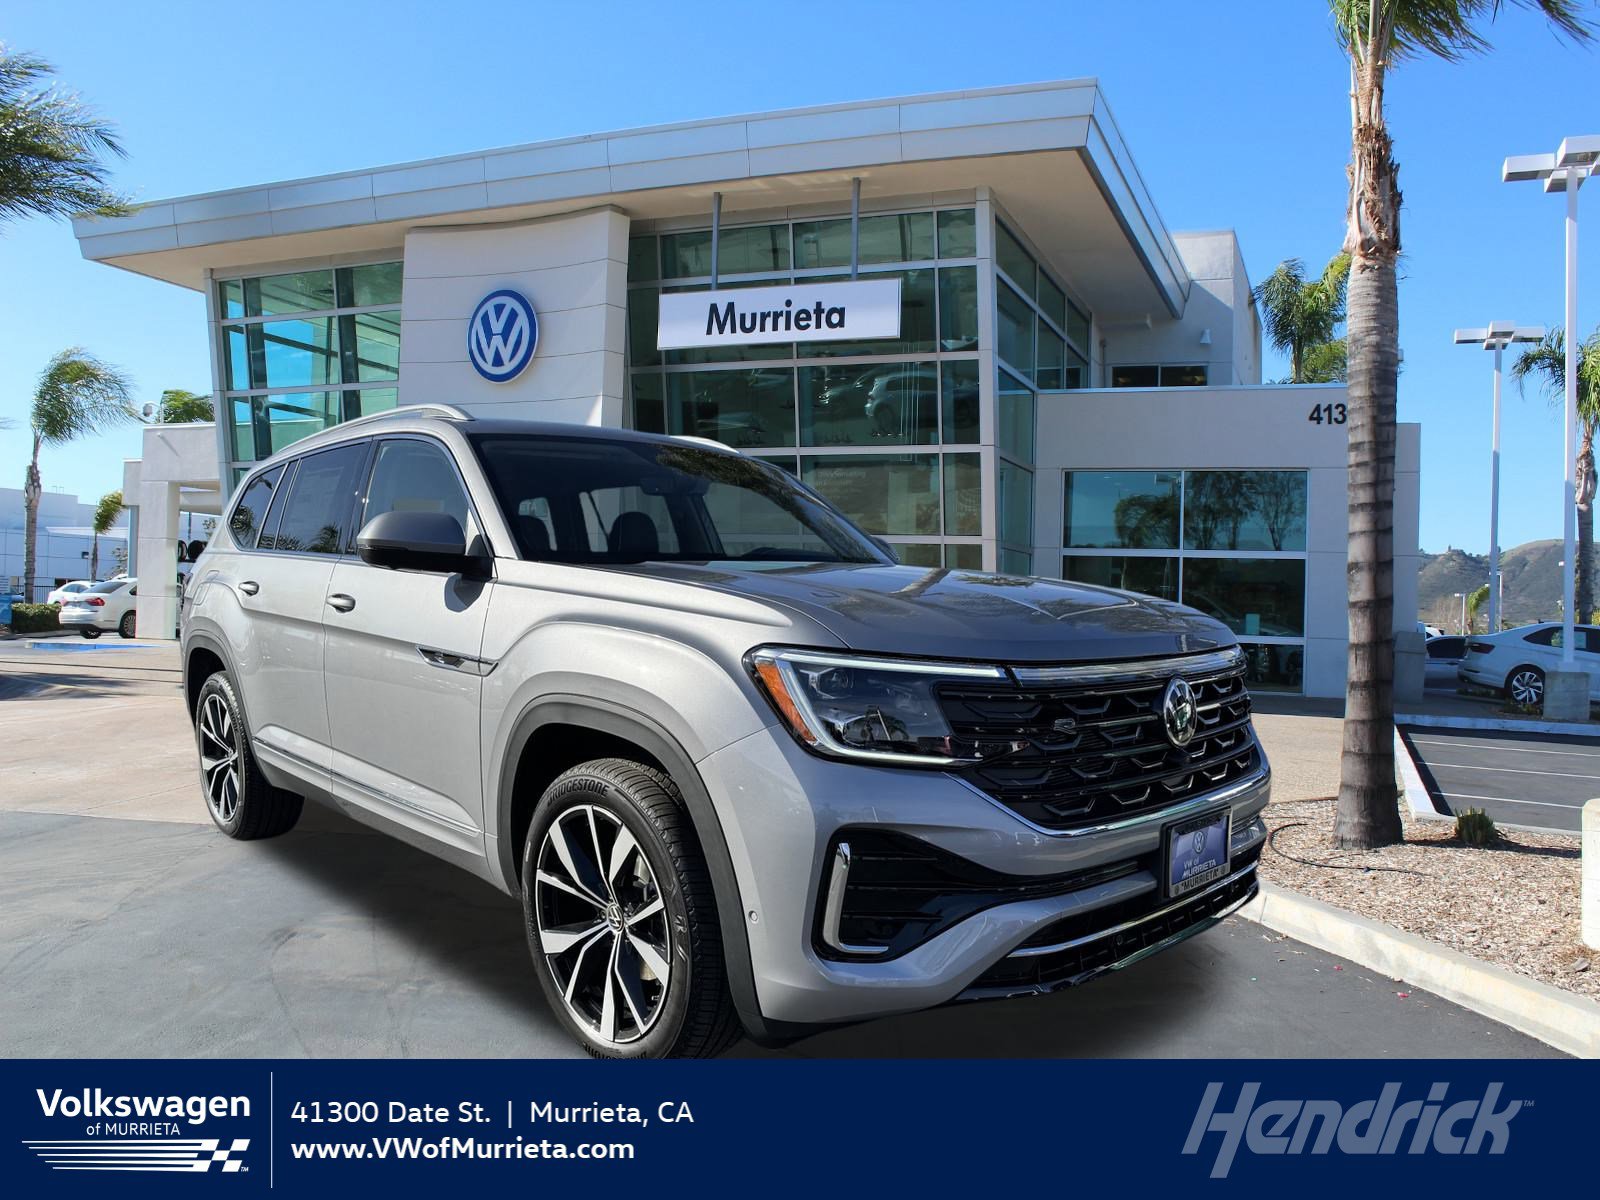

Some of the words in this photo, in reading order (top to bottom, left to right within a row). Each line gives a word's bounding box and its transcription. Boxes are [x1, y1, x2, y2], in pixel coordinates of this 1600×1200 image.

[706, 298, 846, 336] Murrieta
[470, 294, 531, 376] VW
[1308, 403, 1347, 425] 413
[1181, 858, 1217, 879] MURRIETA
